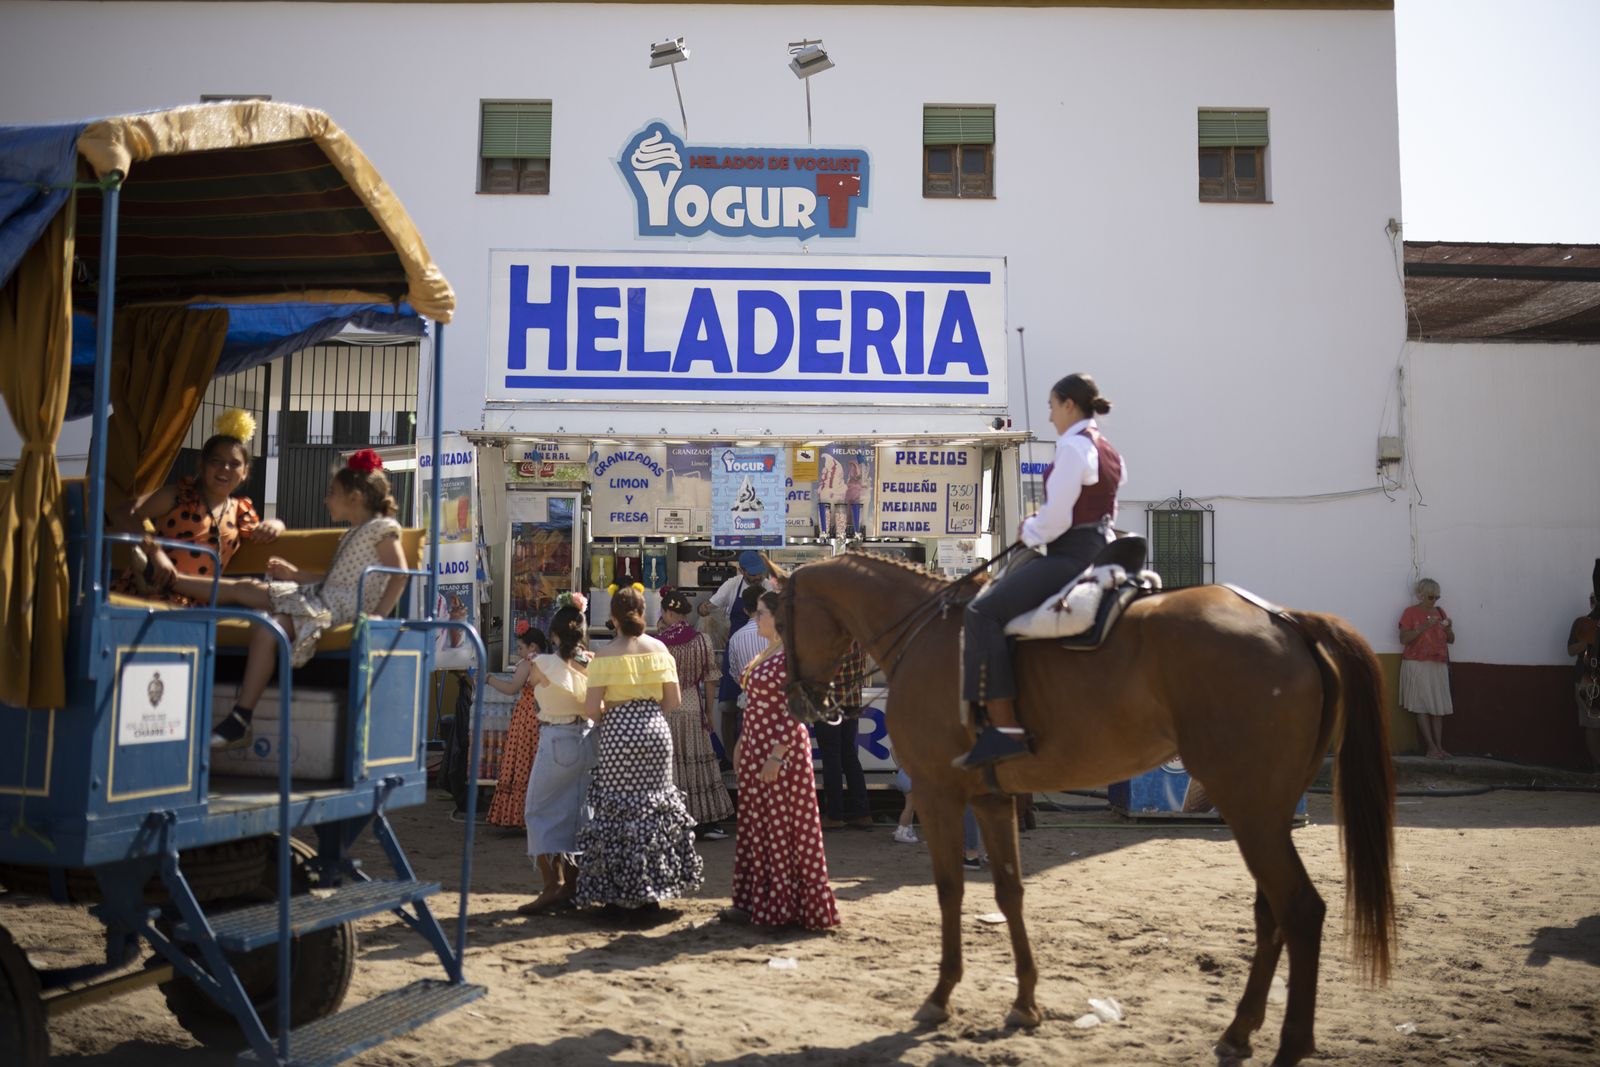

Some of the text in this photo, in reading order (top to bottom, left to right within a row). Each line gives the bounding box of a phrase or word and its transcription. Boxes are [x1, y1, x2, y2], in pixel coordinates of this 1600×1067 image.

[690, 156, 861, 172] HELADOS DE YOGURT
[507, 264, 989, 375] HELADERIA
[594, 451, 665, 477] GRANIZADAS
[895, 451, 968, 465] PRECIOS
[609, 478, 649, 489] LIMON
[882, 480, 937, 493] PEQUEÑO
[625, 495, 634, 505] Y
[881, 502, 937, 512] MEDIANO
[610, 512, 649, 522] FRESA
[881, 522, 930, 532] GRANDE
